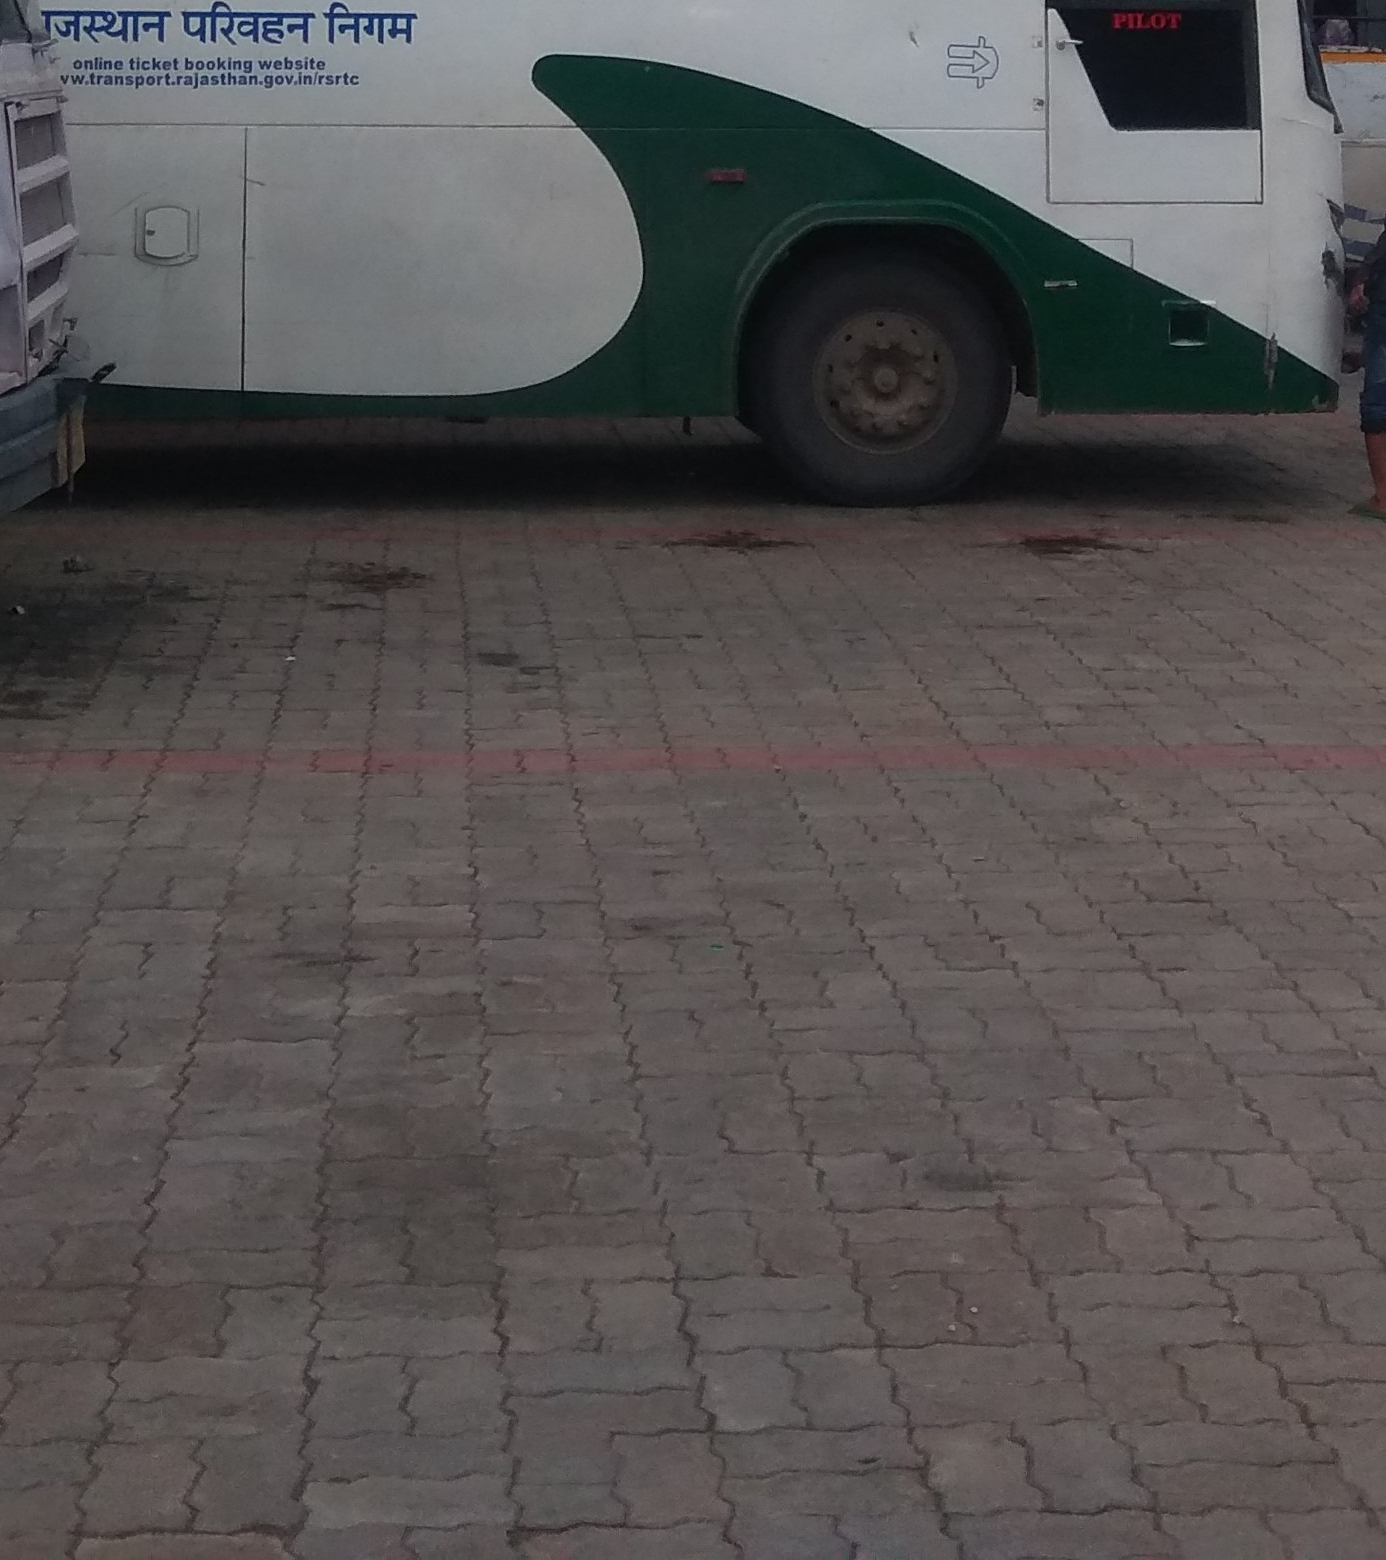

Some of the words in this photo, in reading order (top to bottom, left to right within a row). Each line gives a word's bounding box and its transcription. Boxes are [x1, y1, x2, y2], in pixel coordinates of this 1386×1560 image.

[41, 10, 172, 43] ाजस्थान
[181, 1, 316, 45] परिवहन
[323, 2, 418, 44] निगम
[1112, 12, 1182, 29] PILOT
[73, 57, 123, 71] online
[129, 57, 179, 71] ticket
[184, 57, 253, 74] booking
[258, 57, 326, 71] website
